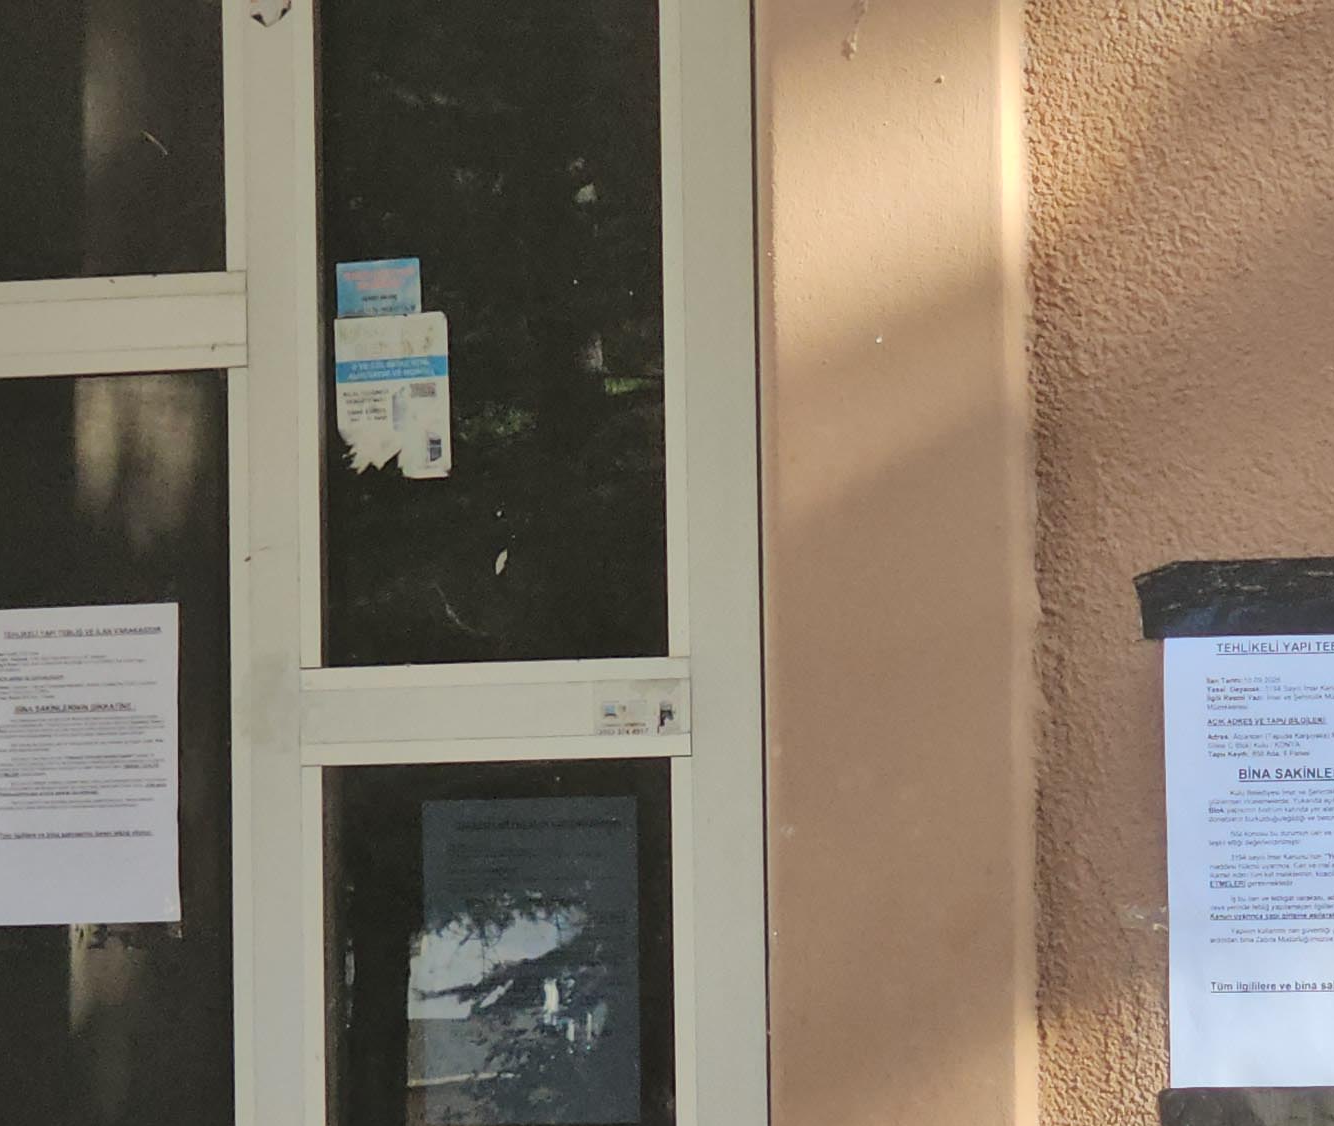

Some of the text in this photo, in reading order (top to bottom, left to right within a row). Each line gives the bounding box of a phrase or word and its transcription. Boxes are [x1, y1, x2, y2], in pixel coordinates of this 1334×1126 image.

[1216, 640, 1279, 653] TEHLİKELİ
[1283, 641, 1312, 652] YAPI
[1239, 766, 1270, 780] BİNA
[1211, 980, 1234, 992] Tüm
[1236, 979, 1277, 992] ilgililere
[1279, 983, 1292, 991] ve
[1295, 979, 1318, 991] bina
